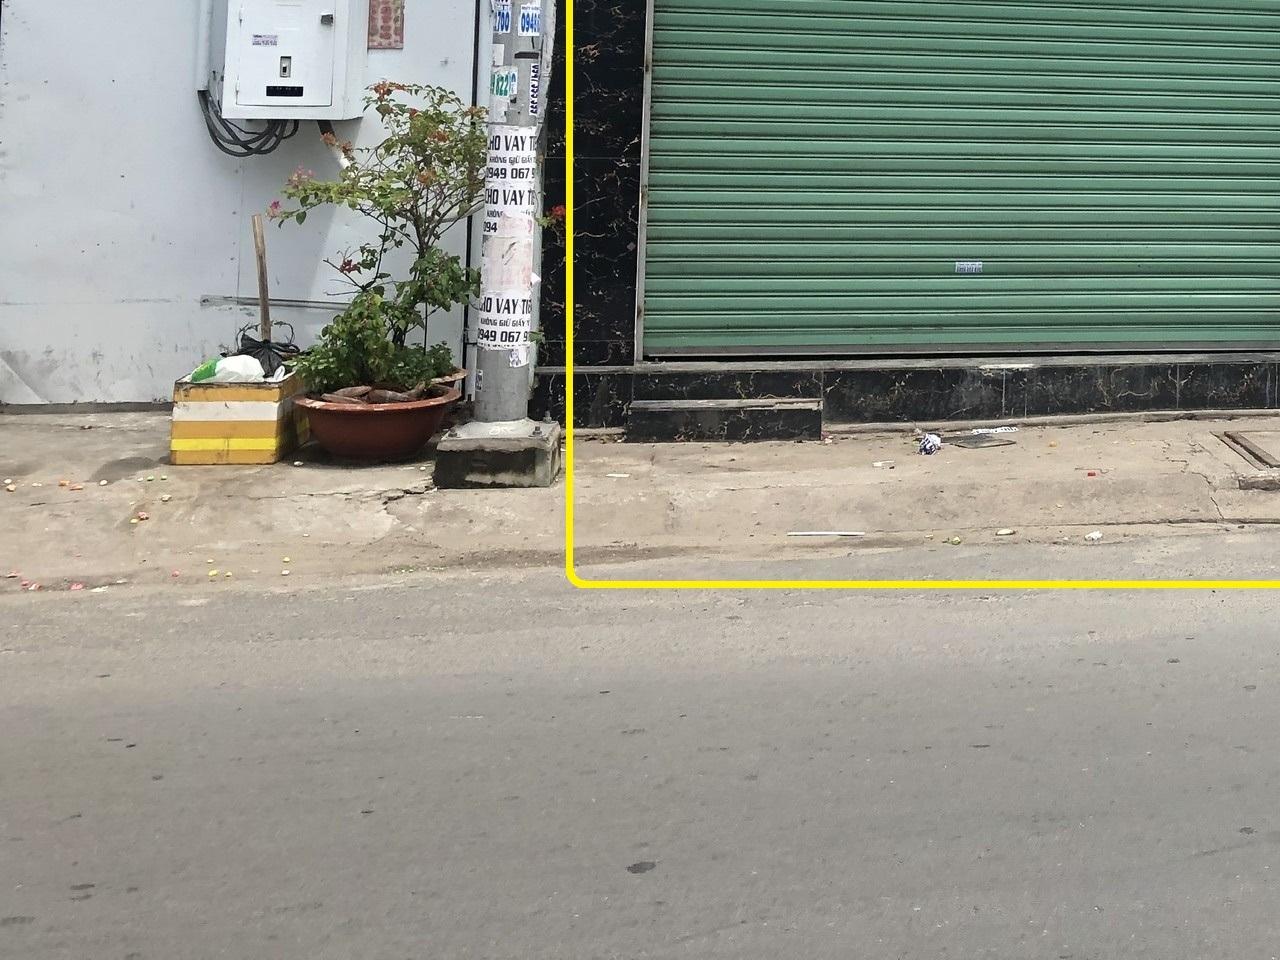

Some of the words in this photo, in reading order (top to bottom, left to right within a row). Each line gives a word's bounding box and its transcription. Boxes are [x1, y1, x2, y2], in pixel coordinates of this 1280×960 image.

[504, 135, 527, 151] VAY
[511, 167, 530, 179] 067
[502, 189, 525, 206] VAY
[496, 298, 519, 315] VAY
[500, 330, 521, 342] 067
